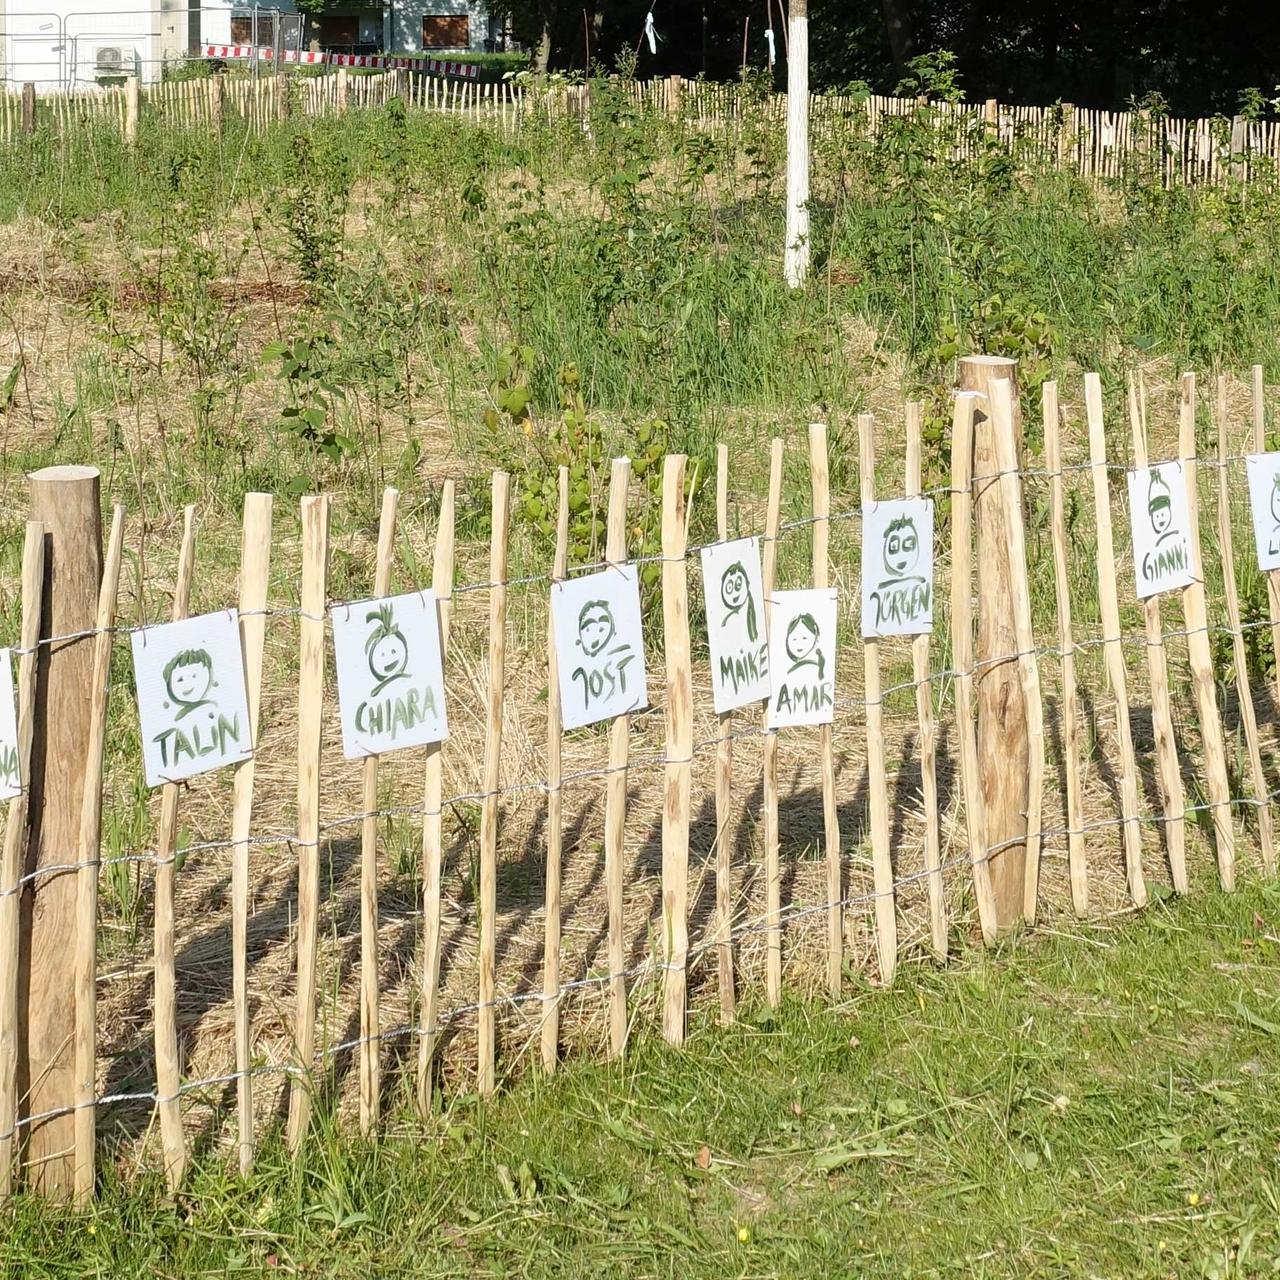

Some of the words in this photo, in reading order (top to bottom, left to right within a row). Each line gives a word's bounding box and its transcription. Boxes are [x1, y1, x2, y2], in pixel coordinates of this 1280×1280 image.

[870, 582, 931, 629] JÜRGEN
[572, 654, 636, 710] JOST
[776, 682, 833, 716] AMAR
[355, 684, 439, 740] CHIARA
